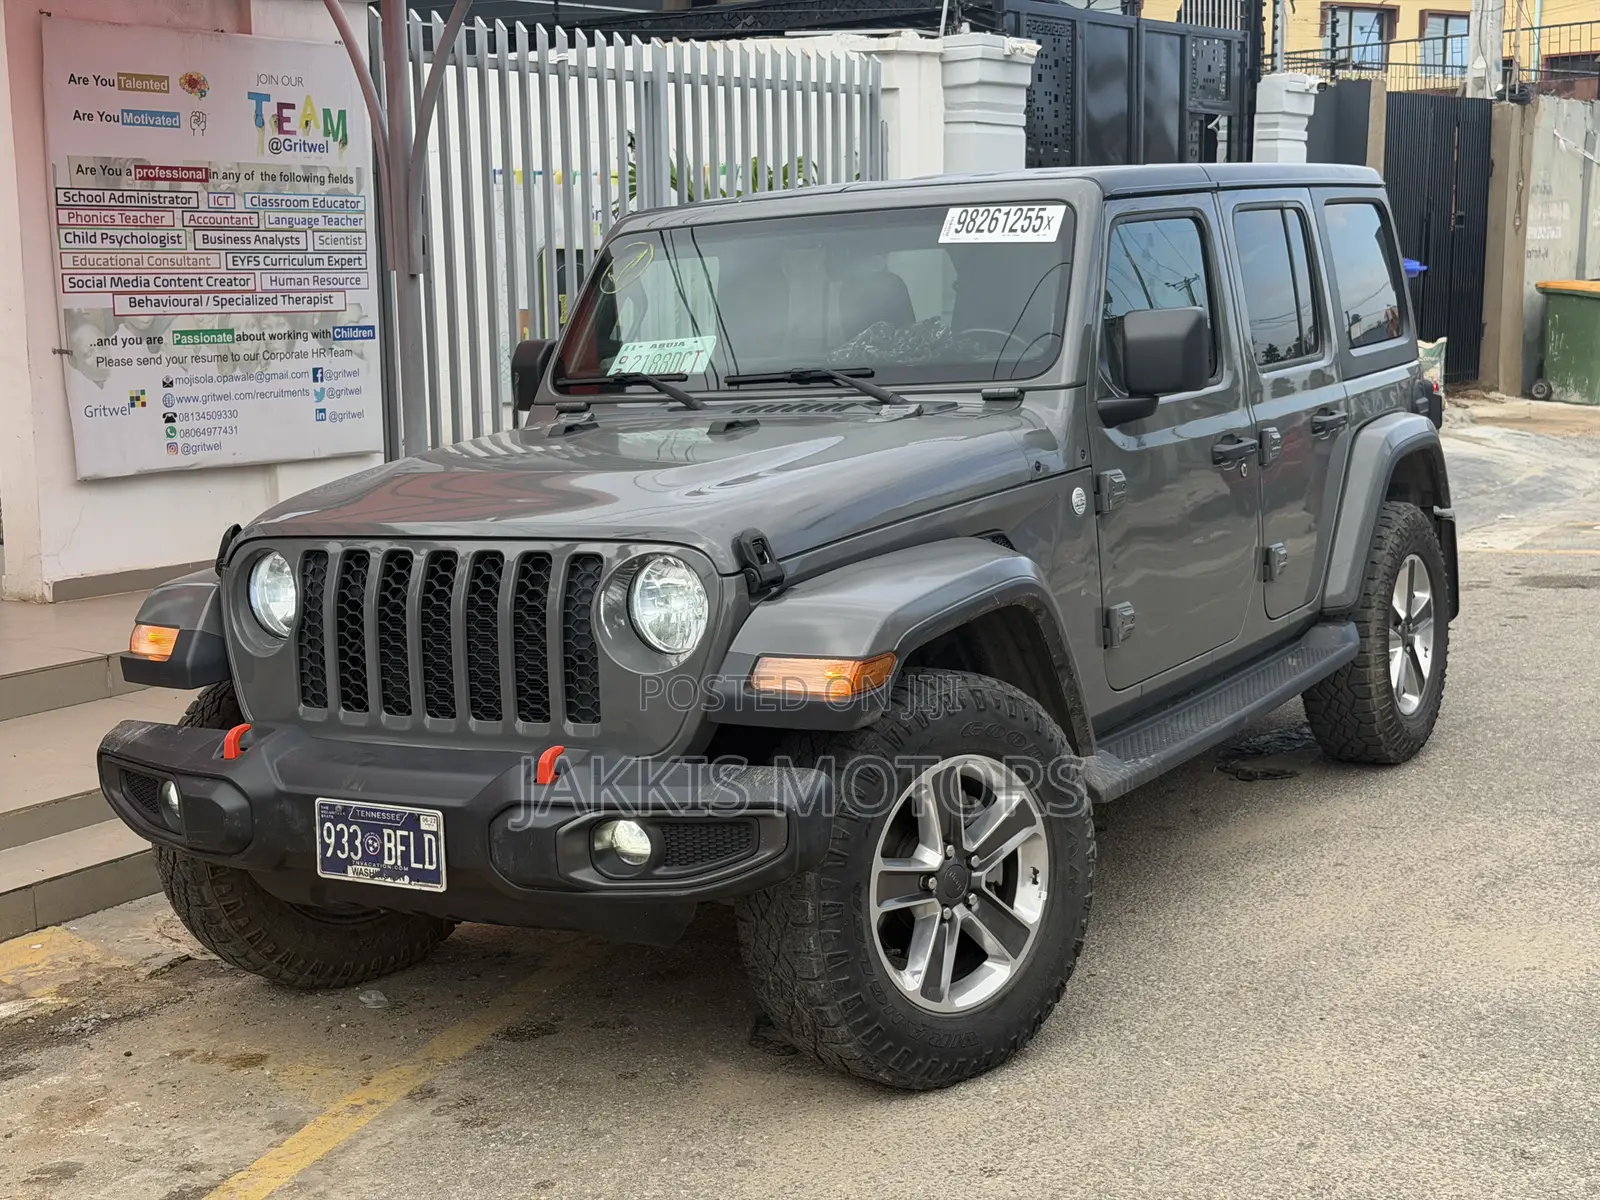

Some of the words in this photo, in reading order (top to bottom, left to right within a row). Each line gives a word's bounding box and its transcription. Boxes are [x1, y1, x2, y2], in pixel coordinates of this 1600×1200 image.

[68, 73, 89, 86] Are
[92, 74, 115, 87] You
[118, 76, 168, 90] Talented
[256, 74, 278, 86] JOIN
[281, 75, 304, 87] OUR
[73, 110, 94, 122] Are
[97, 110, 120, 122] You
[123, 112, 180, 126] Motivated
[247, 91, 348, 146] TEAM
[268, 137, 329, 154] @Gritwel
[76, 164, 96, 176] Are
[100, 164, 122, 176] You
[125, 168, 132, 176] a
[136, 166, 206, 180] professional
[209, 169, 218, 180] in
[222, 172, 241, 183] any
[244, 170, 256, 181] of
[260, 171, 276, 182] the
[280, 171, 326, 186] following
[328, 173, 354, 184] fields
[63, 191, 105, 204] School
[108, 192, 193, 205] Administrator
[213, 196, 230, 206] ICT
[250, 196, 310, 208] Classroom
[312, 197, 361, 209] Educator
[68, 212, 116, 224] Phonics
[118, 212, 165, 224] Teacher
[188, 214, 254, 226] Accountant
[268, 214, 320, 228] Language
[322, 215, 364, 226] Teacher
[64, 232, 97, 244] Child
[100, 232, 182, 248] Psychologist
[202, 234, 251, 245] Business
[254, 234, 300, 247] Analysts
[318, 234, 362, 246] Scientist
[72, 254, 144, 266] Educational
[148, 255, 211, 266] Consultant
[232, 255, 260, 266] EYFS
[263, 254, 324, 266] Curriculum
[328, 256, 362, 269] Expert
[68, 276, 106, 288] Social
[110, 276, 150, 288] Media
[154, 276, 204, 288] Content
[206, 276, 250, 287] Creator
[270, 275, 310, 286] Human
[313, 276, 361, 286] Resource
[128, 296, 202, 308] Behavioural
[205, 296, 210, 307] /
[212, 294, 278, 309] Specialized
[280, 294, 334, 307] Therapist
[121, 338, 142, 348] you
[146, 336, 164, 345] are
[173, 332, 232, 344] Passionate
[236, 330, 266, 342] about
[268, 330, 308, 342] working
[312, 329, 332, 340] with
[334, 328, 373, 338] Children
[96, 356, 132, 368] Please
[136, 354, 162, 366] send
[166, 356, 188, 368] your
[190, 354, 228, 364] resume
[231, 352, 240, 362] to
[244, 353, 260, 362] our
[262, 350, 308, 362] Corporate
[312, 348, 326, 358] HR
[329, 348, 353, 358] Team
[175, 370, 310, 387] mojisola.opawale@gmail.com
[324, 368, 360, 382] @gritwel
[176, 388, 310, 404] www.gritwel.com/recruitments
[326, 386, 362, 399] @gritwel
[84, 402, 131, 418] Gritwel
[178, 410, 238, 422] 08134509330
[329, 409, 365, 423] @gritwel
[179, 426, 238, 438] 08064977431
[180, 440, 222, 456] @gritwel
[356, 810, 402, 821] TENNESSEE
[322, 822, 362, 860] 933
[382, 828, 437, 870] BFLD
